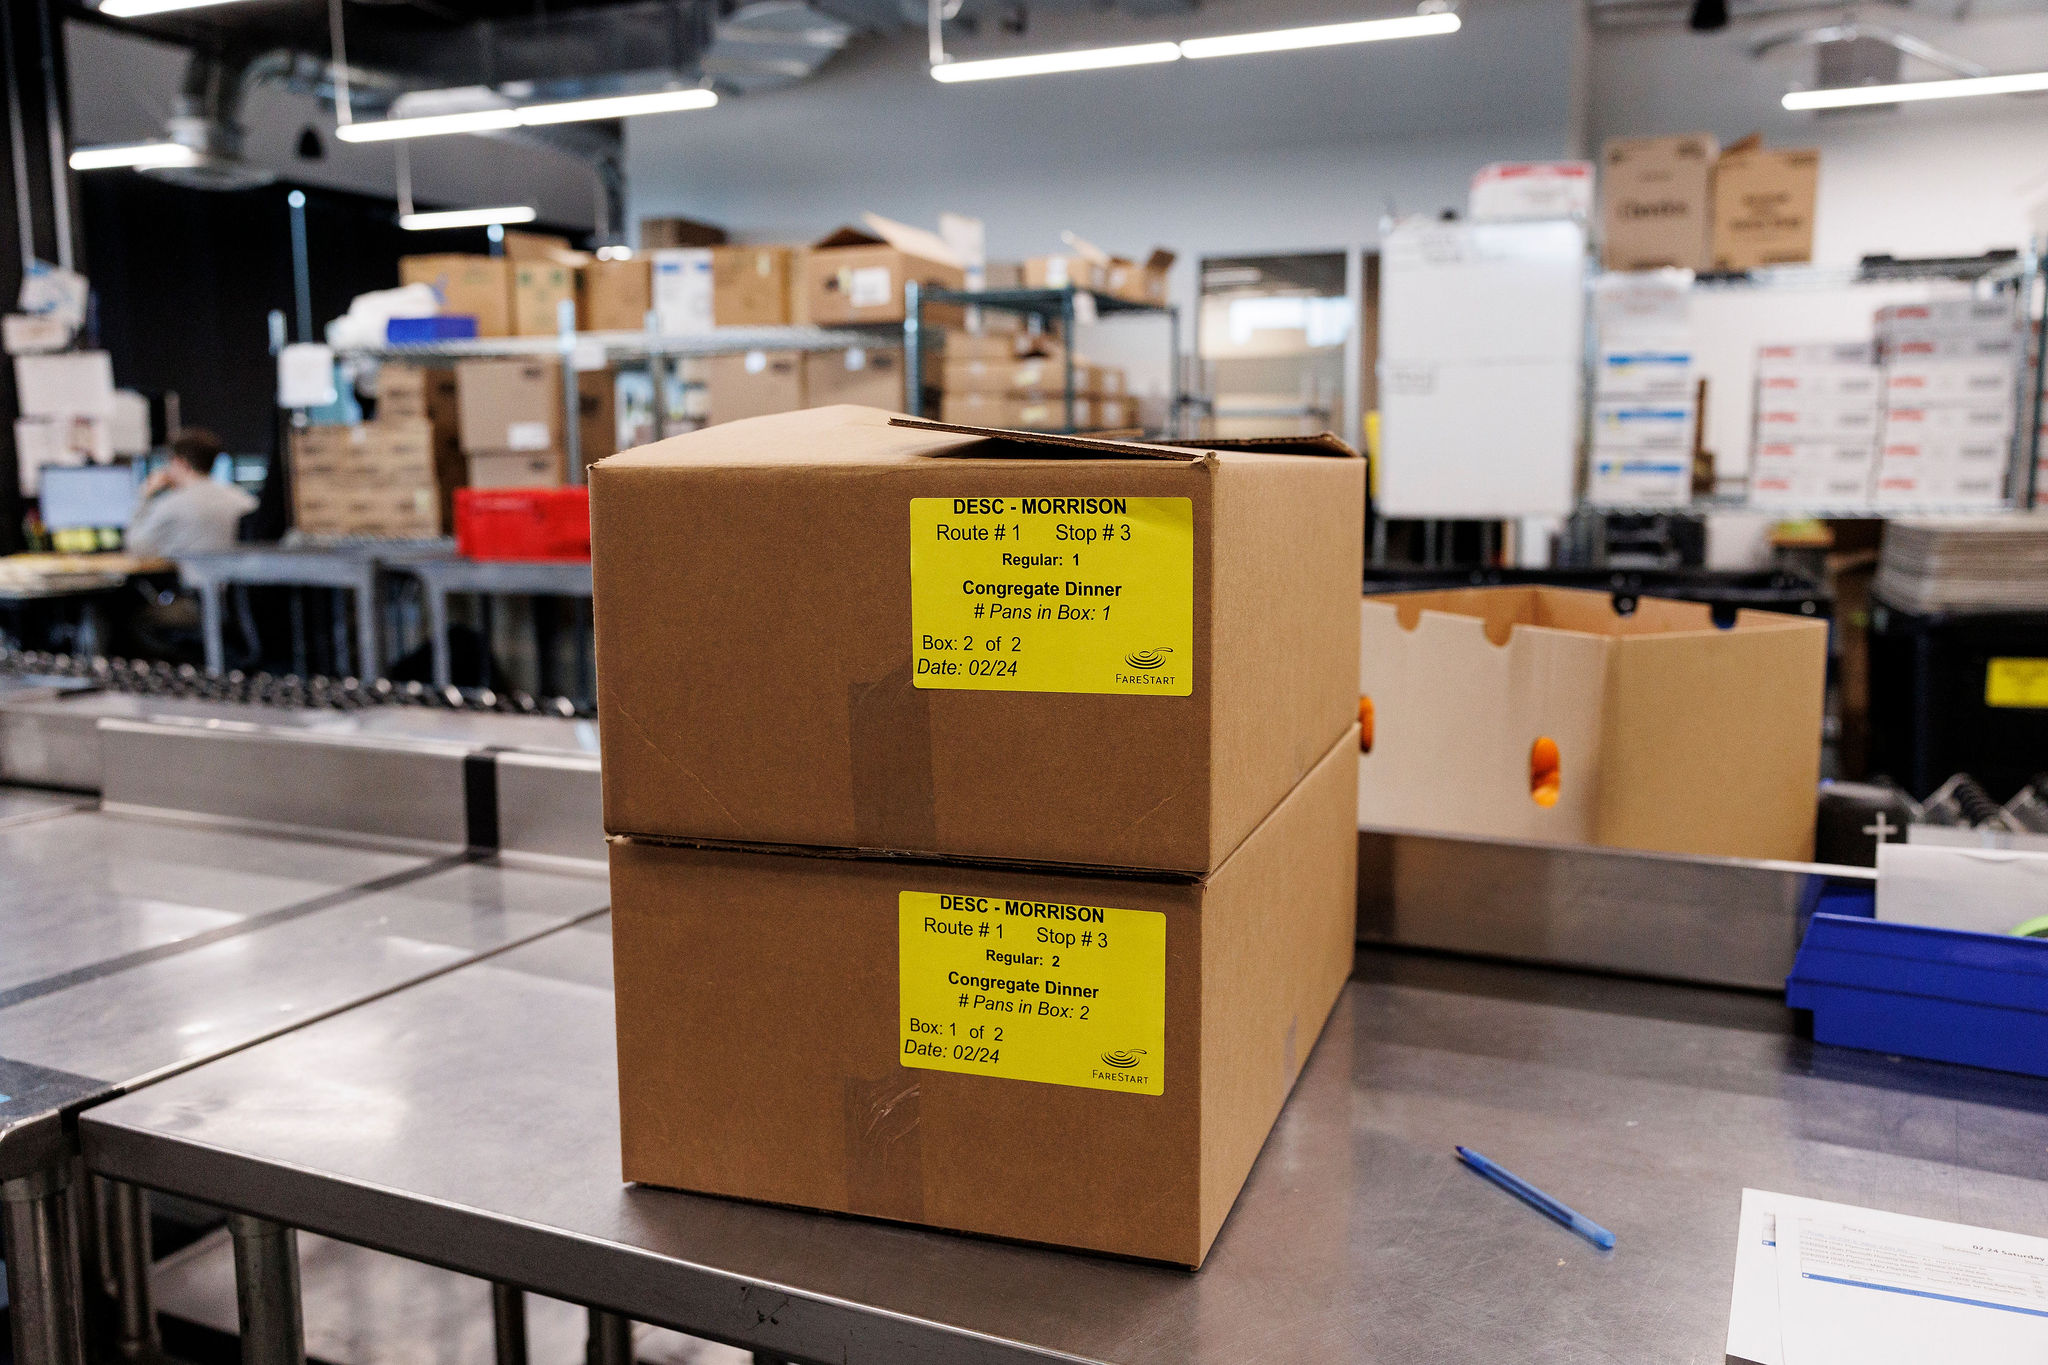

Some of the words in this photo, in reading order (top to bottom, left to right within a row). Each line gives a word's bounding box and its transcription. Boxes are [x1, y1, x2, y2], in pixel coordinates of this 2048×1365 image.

[954, 499, 1004, 514] DESC
[1022, 498, 1128, 514] MORRISON
[937, 524, 988, 540] Route
[994, 524, 1006, 541] #
[1012, 524, 1020, 540] 1
[1056, 524, 1097, 544] Stop
[1102, 524, 1114, 541] #
[1120, 524, 1132, 541] 3
[1003, 553, 1062, 569] Regular:
[1072, 553, 1079, 566] 1
[963, 580, 1059, 598] Congregate
[1066, 581, 1122, 596] Dinner
[973, 604, 986, 618] #
[990, 603, 1032, 619] Pans
[1037, 604, 1051, 619] in
[1058, 604, 1095, 620] Box:
[1102, 605, 1111, 620] 1
[923, 635, 957, 650] Box:
[963, 636, 974, 651] 2
[986, 636, 1002, 651] of
[1011, 637, 1022, 652] 2
[917, 658, 962, 675] Date:
[969, 660, 1017, 676] 02/24
[941, 895, 989, 913] DESC
[1005, 900, 1104, 923] MORRISON
[925, 917, 973, 936] Route
[977, 922, 990, 937] #
[995, 924, 1003, 939] 1
[1037, 927, 1075, 948] Stop
[1080, 931, 1093, 947] #
[1097, 933, 1108, 948] 3
[986, 949, 1043, 966] Regular:
[1051, 955, 1061, 967] 2
[948, 971, 1040, 993] Congregate
[1045, 981, 1099, 998] Dinner
[957, 993, 970, 1007] #
[974, 995, 1013, 1012] Pans
[1019, 999, 1032, 1014] in
[1038, 1001, 1073, 1018] Box:
[1079, 1006, 1090, 1020] 2
[911, 1018, 942, 1035] Box:
[949, 1022, 956, 1036] 1
[970, 1025, 984, 1039] of
[993, 1027, 1004, 1041] 2
[905, 1039, 947, 1058] Date:
[954, 1045, 999, 1064] 02/24
[2001, 1250, 2046, 1262] Saturday
